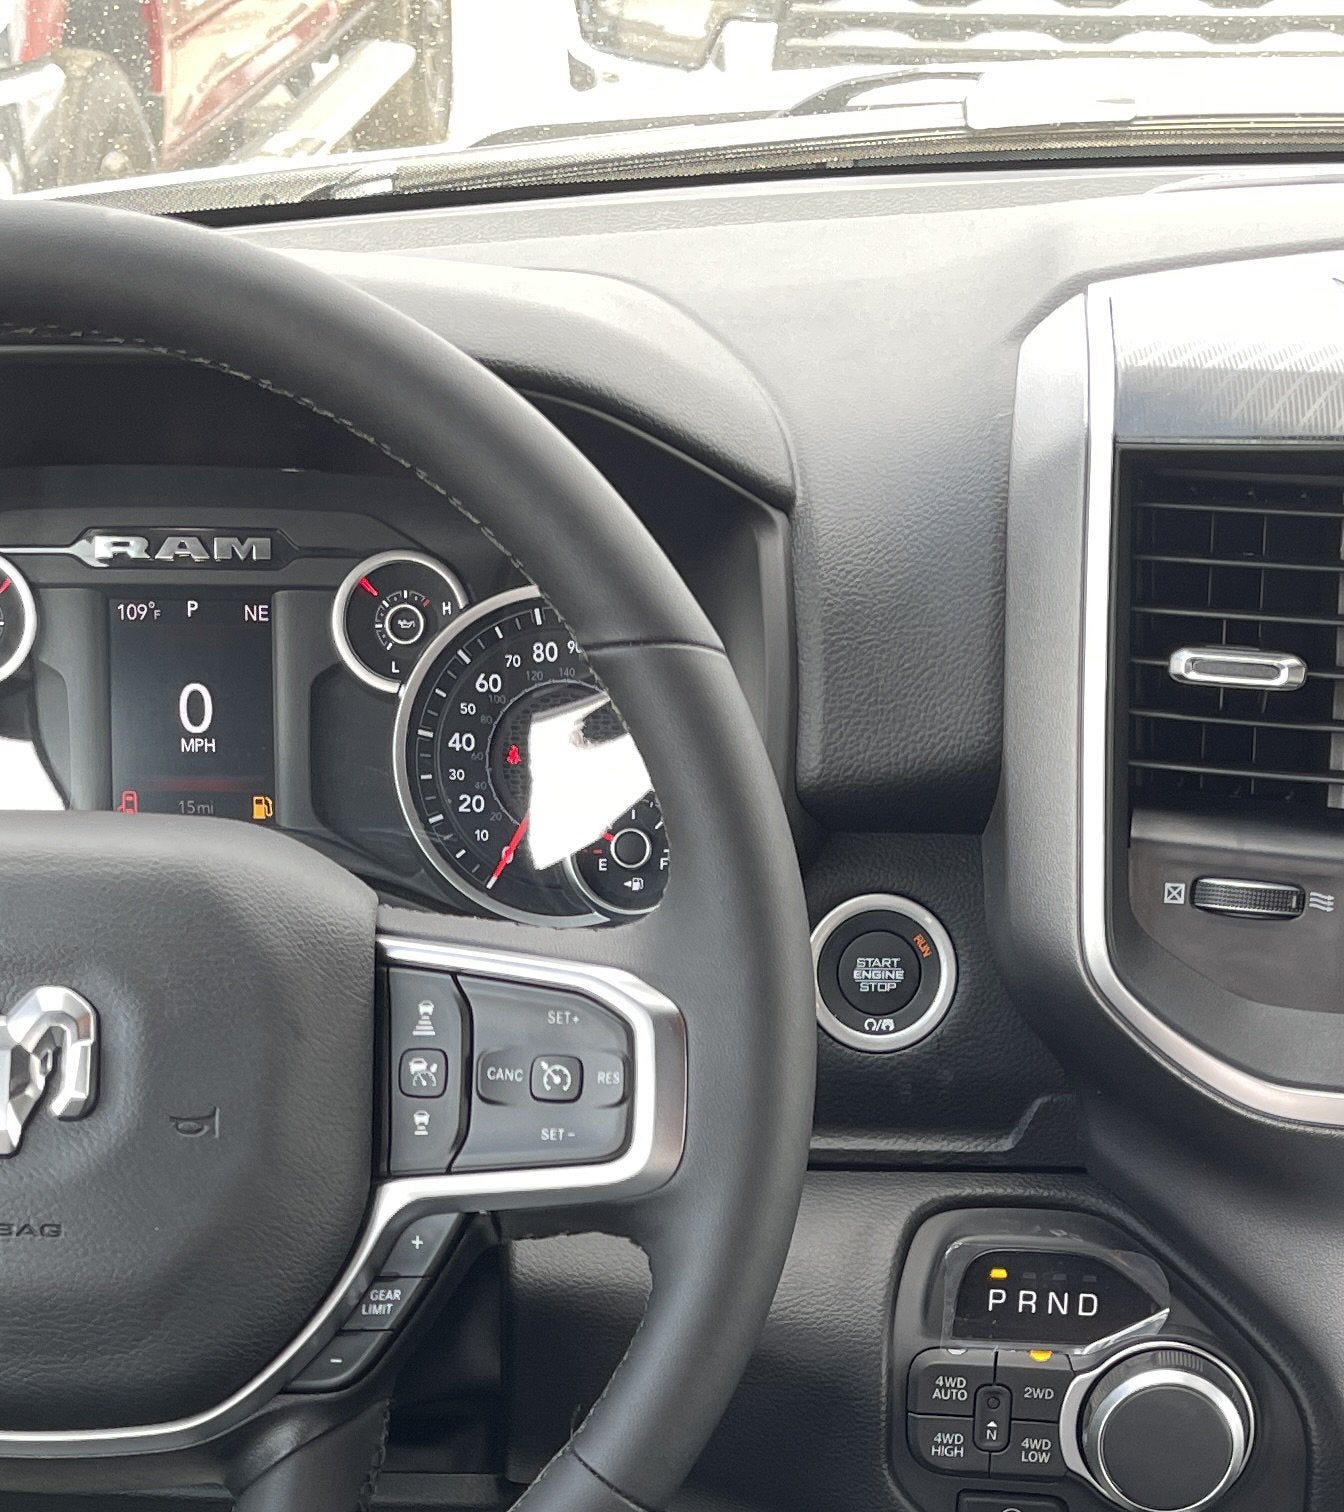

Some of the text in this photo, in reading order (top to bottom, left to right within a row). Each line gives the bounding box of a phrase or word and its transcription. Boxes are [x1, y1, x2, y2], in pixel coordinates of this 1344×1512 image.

[94, 536, 271, 562] RAM
[187, 600, 199, 617] P
[244, 604, 269, 621] NE
[442, 601, 452, 615] H
[532, 641, 558, 662] 80
[391, 661, 399, 673] L
[505, 654, 521, 668] 70
[526, 670, 543, 681] 120
[559, 668, 575, 678] 140
[475, 673, 502, 693] 60
[179, 683, 213, 733] 0
[460, 702, 476, 715] 50
[181, 738, 216, 752] MPH
[448, 732, 476, 751] 40
[449, 768, 465, 780] 30
[459, 794, 485, 813] 20
[475, 829, 489, 841] 10
[598, 858, 607, 871] E
[913, 933, 932, 959] RUN
[857, 957, 900, 968] START
[853, 970, 904, 980] ENGINE
[859, 982, 896, 992] STOP
[487, 1066, 523, 1082] CANC
[597, 1071, 620, 1085] RES
[370, 1288, 401, 1302] GEAR
[361, 1303, 393, 1316] LIMIT
[988, 1288, 1098, 1317] P R N D
[935, 1375, 966, 1389] 4WD
[932, 1388, 968, 1402] AUTO
[1024, 1386, 1054, 1400] 2WD
[933, 1432, 964, 1445] 4WD
[987, 1428, 997, 1441] N
[1021, 1437, 1051, 1451] 4WD
[931, 1445, 964, 1458] HIGH
[1021, 1450, 1051, 1464] LOW
